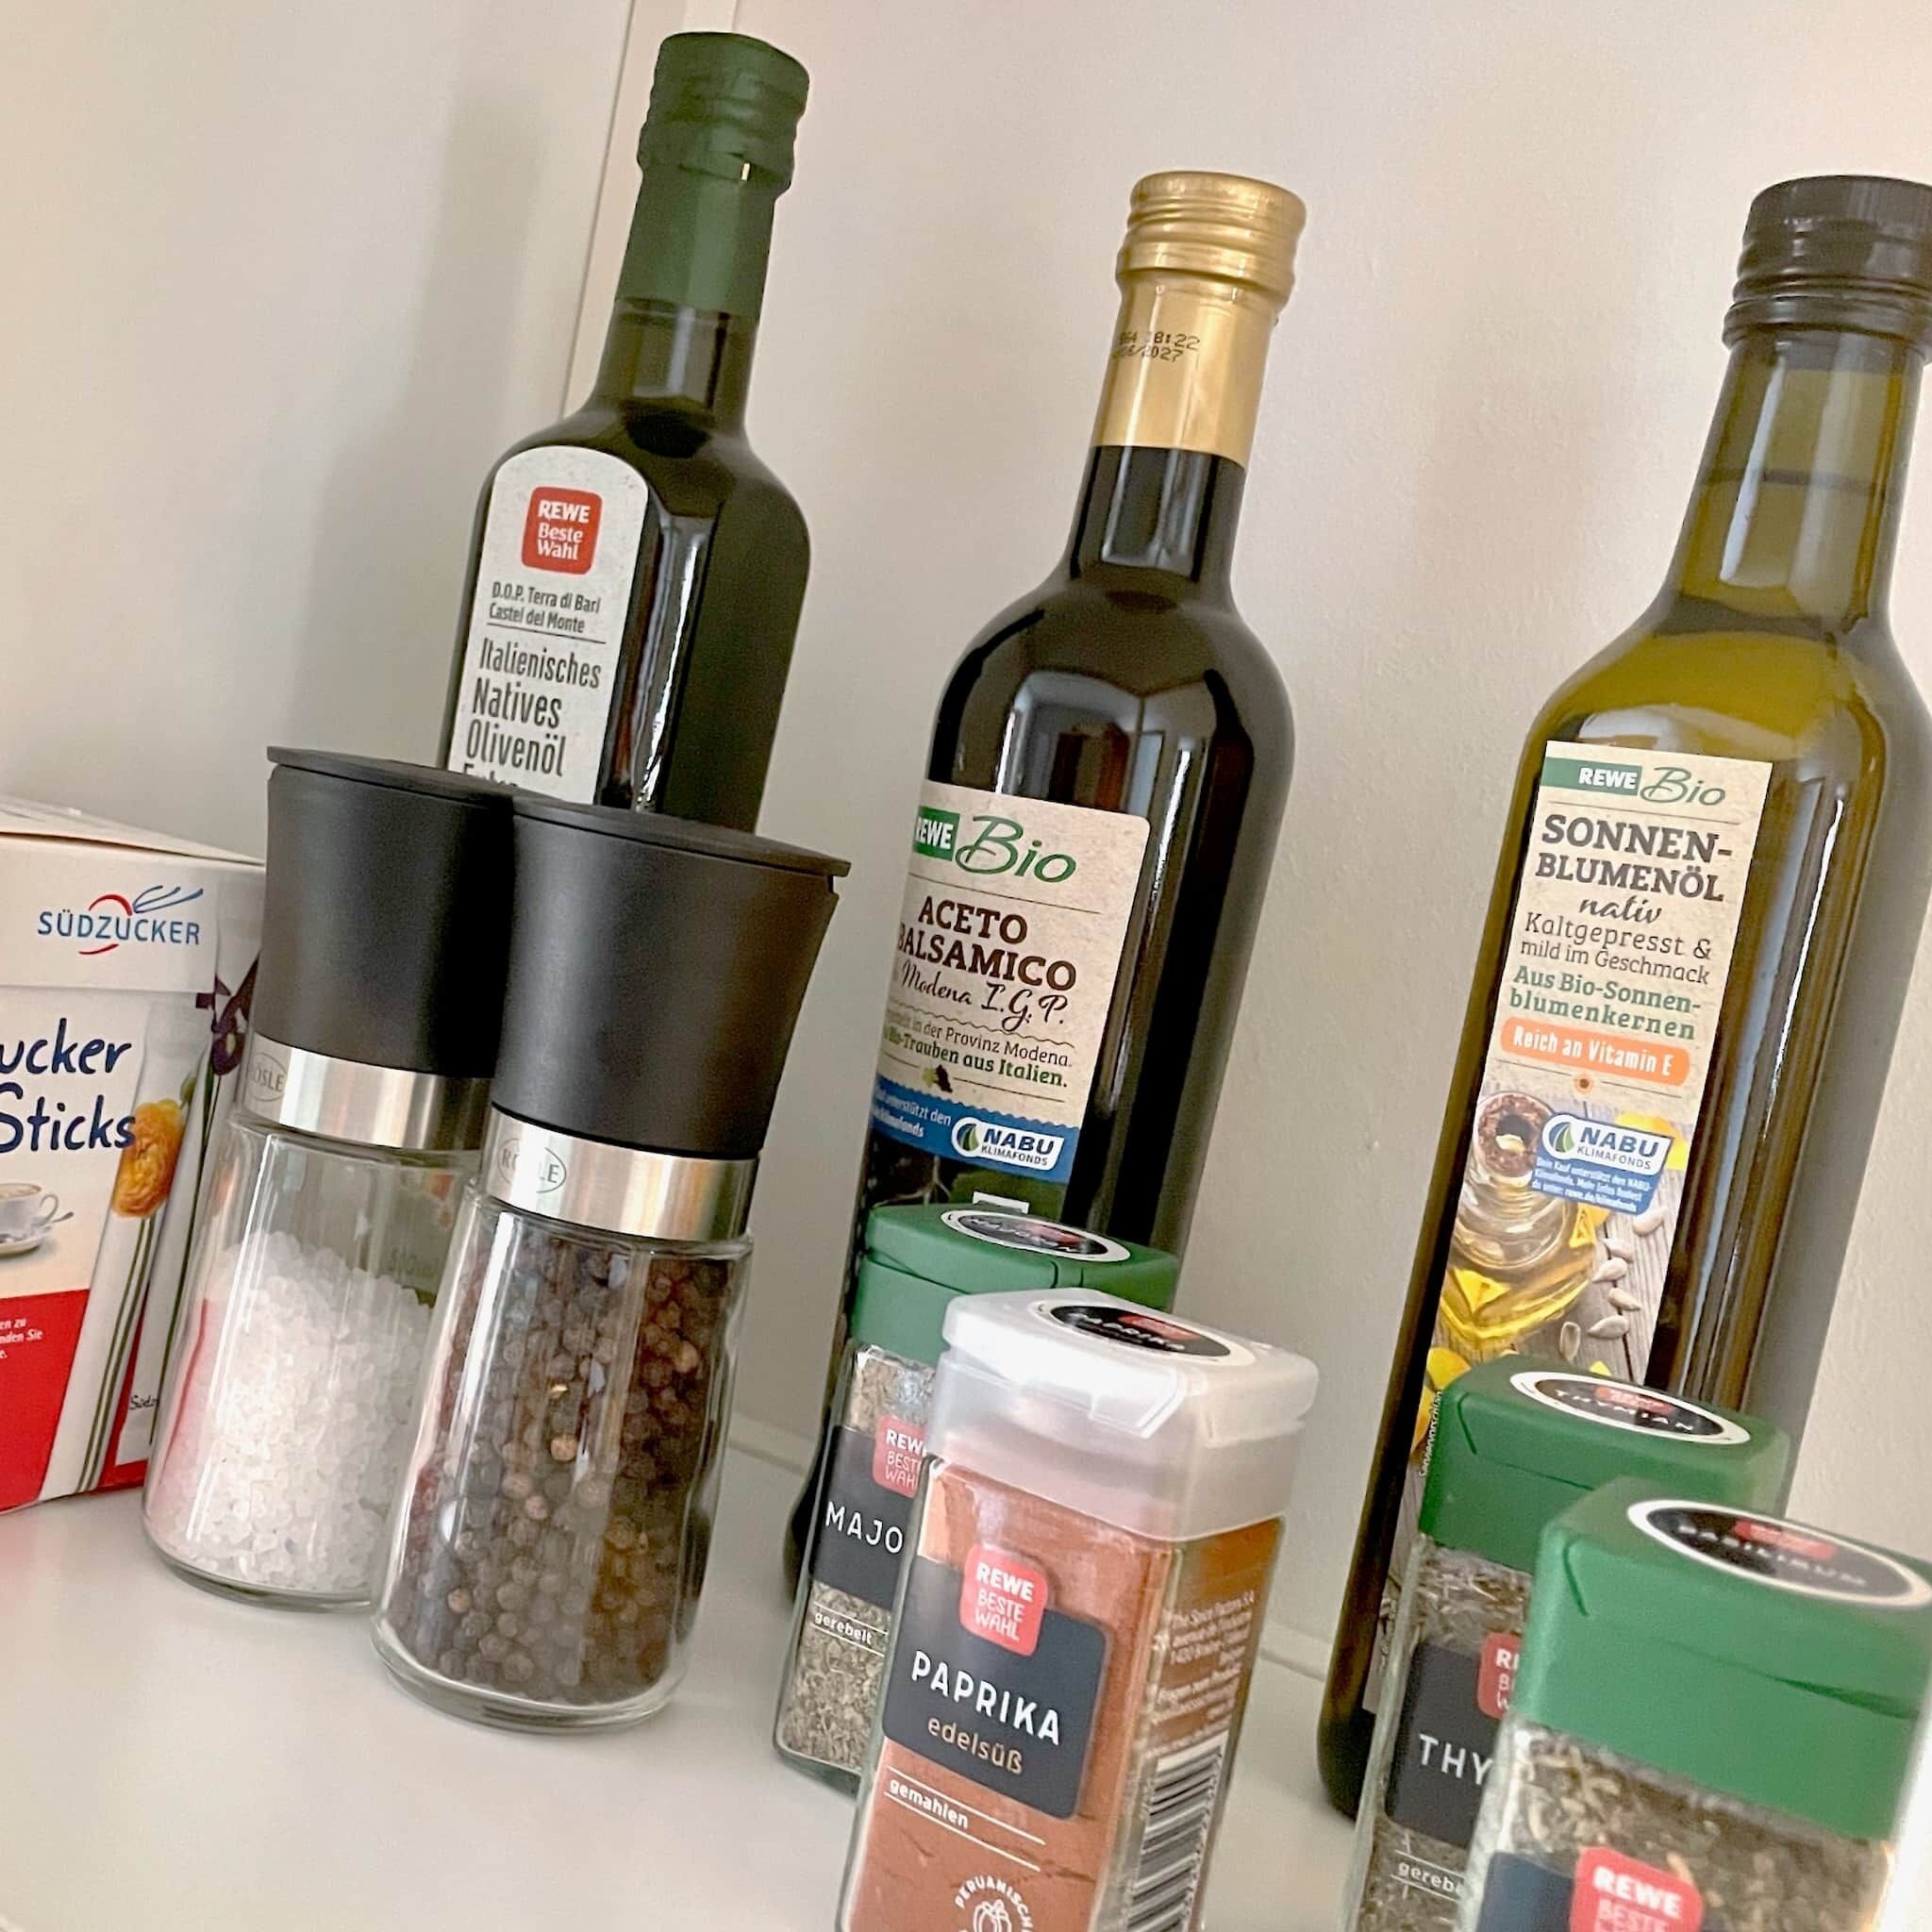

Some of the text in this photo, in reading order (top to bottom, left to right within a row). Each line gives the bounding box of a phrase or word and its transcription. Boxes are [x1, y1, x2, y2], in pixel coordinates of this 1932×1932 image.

[1146, 331, 1200, 353] 8:22
[538, 500, 590, 524] REWE
[539, 522, 583, 543] Beste
[537, 539, 579, 561] Wahl
[490, 602, 585, 633] Castel del Monte
[492, 581, 602, 613] D.O.P. Terra di Bari
[479, 637, 602, 689] Italienisches
[473, 677, 562, 729] Natives
[466, 719, 566, 777] Olivenöl
[1579, 766, 1725, 806] REWE Bio
[955, 815, 1077, 883] Bio
[1541, 814, 1733, 863] SONNEN-
[1535, 853, 1724, 902] BLUMENÖL
[38, 909, 201, 945] SÜDZUCKER
[918, 895, 1028, 945] ACETO
[1579, 894, 1662, 924] nativ
[897, 921, 1077, 991] BALSAMICO
[1524, 912, 1711, 960] Kaltgepresst &
[901, 959, 973, 1006] Modena
[1520, 941, 1710, 985] mild im Geschmack
[1513, 965, 1701, 1013] Aus Bio-Sonnen-
[1509, 989, 1696, 1040] blumenkernen
[0, 1018, 132, 1074] ucker
[924, 1021, 942, 1038] der
[945, 1026, 1000, 1054] Provinz
[1005, 1041, 1073, 1068] Modena.
[1513, 1026, 1675, 1077] Reich an Vitamin E
[963, 1055, 994, 1073] aus
[998, 1058, 1068, 1088] Italien.
[0, 1082, 136, 1155] Sticks
[930, 1108, 952, 1127] den
[981, 1144, 1049, 1166] KLIMAFONDS
[984, 1128, 1055, 1156] NABU
[1577, 1145, 1652, 1171] KLIMAFONDS
[1580, 1126, 1660, 1158] NABU
[825, 1501, 904, 1555] MAJO
[975, 1561, 1035, 1603] REWE
[814, 1611, 874, 1645] gerebelt
[974, 1607, 1021, 1642] WAHL
[977, 1591, 1024, 1624] BESTE
[911, 1650, 1060, 1746] PAPRIKA
[927, 1715, 1024, 1775] edelsüß
[890, 1777, 970, 1829] gemahlen
[1398, 1860, 1465, 1896] gereb
[1592, 1866, 1682, 1919] REWE
[955, 1874, 1035, 1932] PERUANISCH
